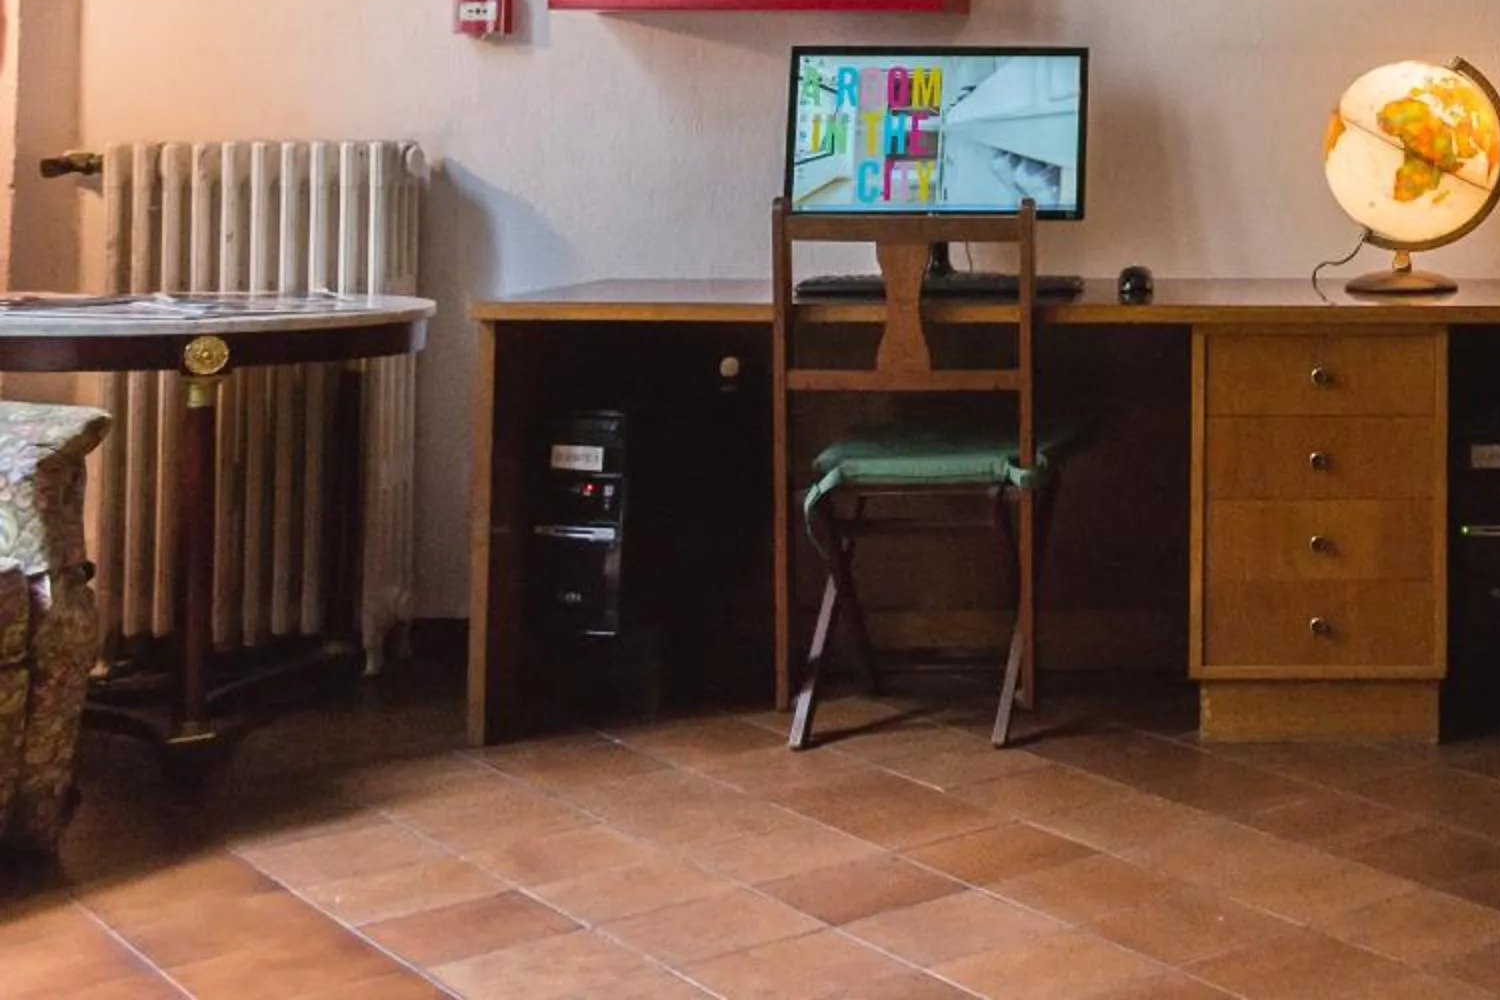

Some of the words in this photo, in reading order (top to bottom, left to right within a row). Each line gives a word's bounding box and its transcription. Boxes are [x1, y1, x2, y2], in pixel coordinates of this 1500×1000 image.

[803, 66, 821, 107] A
[836, 65, 942, 109] ROOM
[810, 113, 848, 154] IN
[862, 111, 930, 156] THE
[856, 159, 935, 203] CITY
